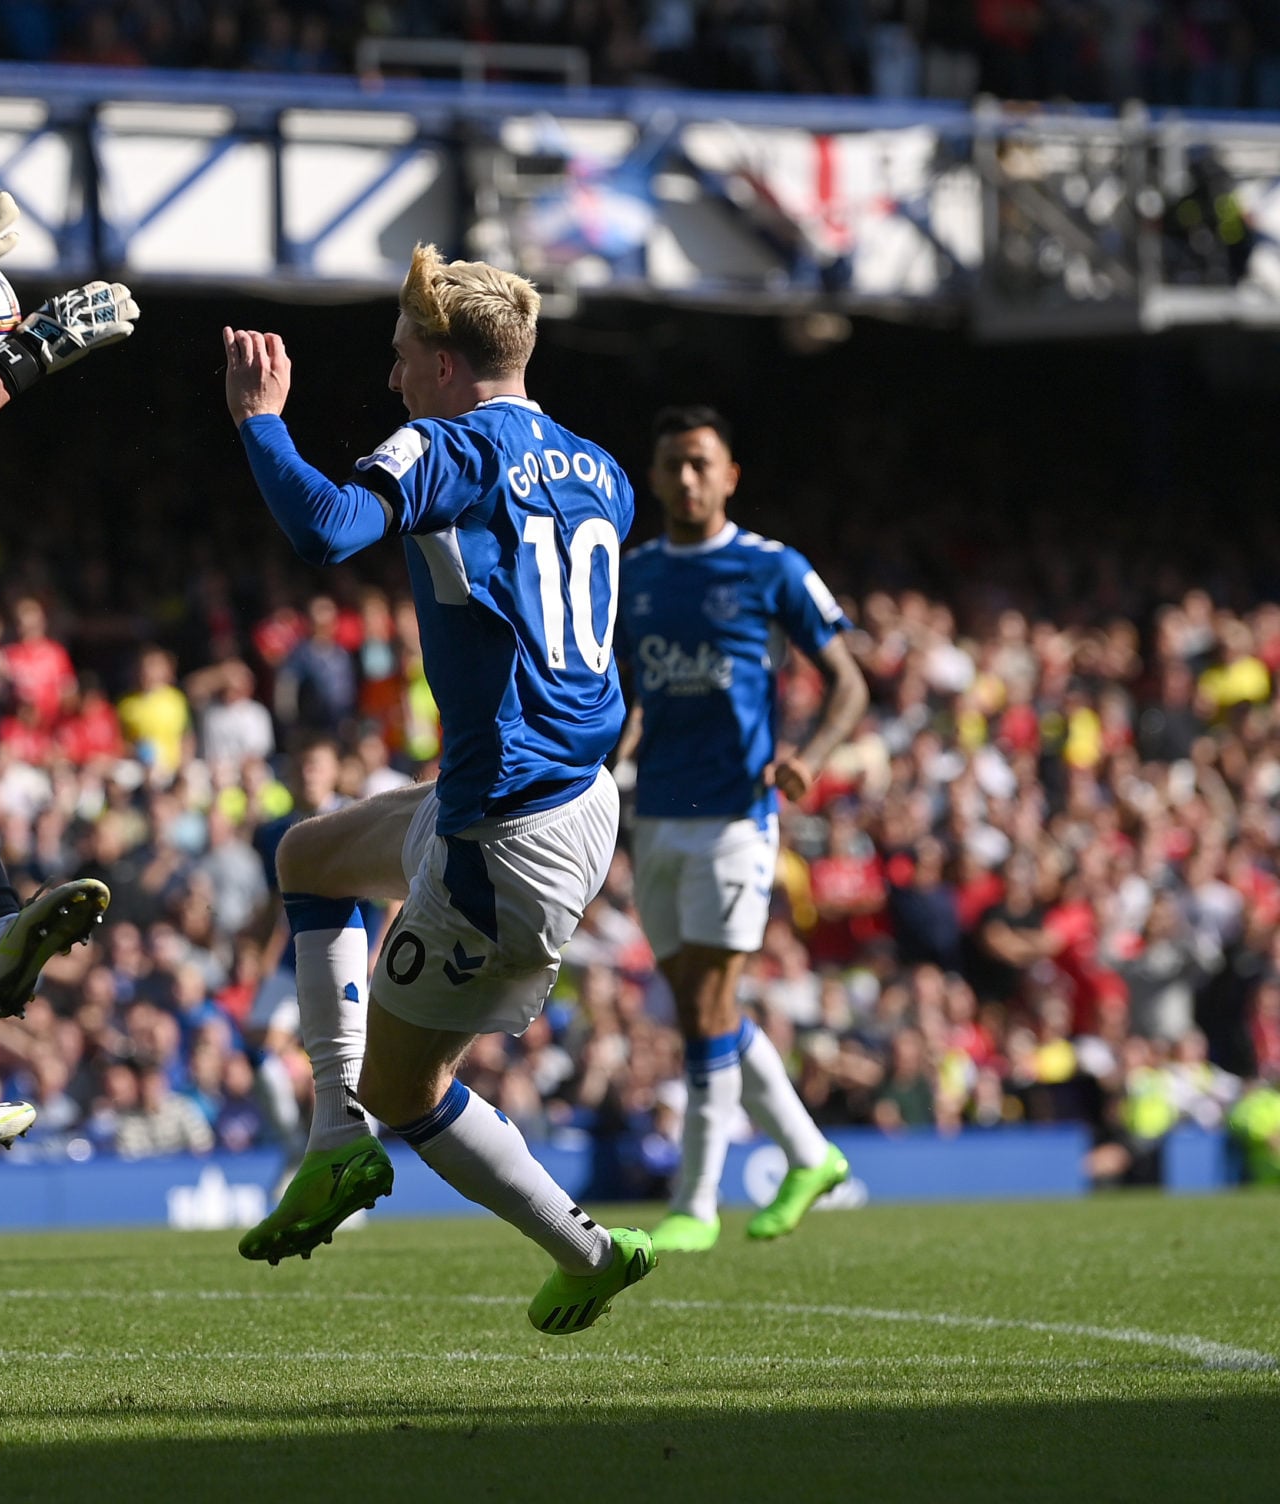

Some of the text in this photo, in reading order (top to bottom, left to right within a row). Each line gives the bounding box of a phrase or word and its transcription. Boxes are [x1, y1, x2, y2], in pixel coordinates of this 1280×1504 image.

[523, 515, 620, 674] 10
[723, 881, 744, 923] 7
[380, 906, 426, 985] 0
